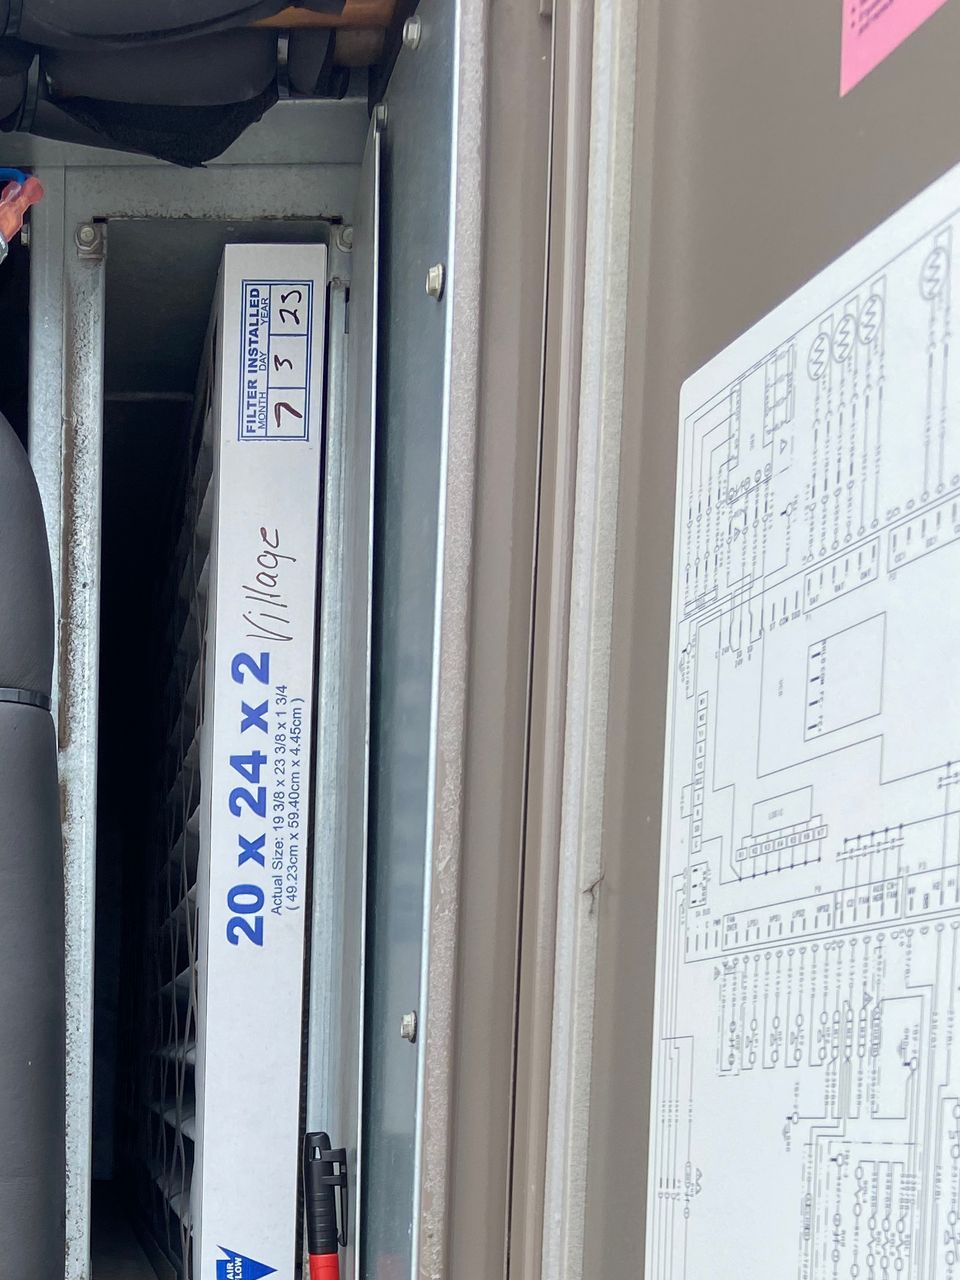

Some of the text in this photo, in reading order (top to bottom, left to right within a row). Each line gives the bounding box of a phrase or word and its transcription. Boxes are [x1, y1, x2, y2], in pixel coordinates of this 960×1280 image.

[247, 288, 260, 433] FILTER INSTALLED
[258, 298, 269, 429] MONTH DAY YEAR
[274, 355, 293, 371] 3
[274, 401, 303, 428] 7
[242, 526, 296, 642] Village
[274, 685, 288, 708] 3/4
[277, 722, 287, 730] x
[289, 707, 302, 756] 4.45cm
[274, 734, 287, 754] 3/8
[274, 758, 286, 775] 23
[291, 759, 301, 767] x
[276, 779, 286, 787] x
[226, 652, 270, 947] 20 x 24 x 2
[272, 791, 286, 812] 3/8
[288, 771, 301, 829] 59.40cm
[273, 815, 285, 832] 19
[290, 832, 299, 840] x
[272, 837, 285, 870] Size:
[287, 845, 299, 902] 49.23cm
[271, 875, 284, 916] Actual
[226, 1262, 234, 1280] AIR
